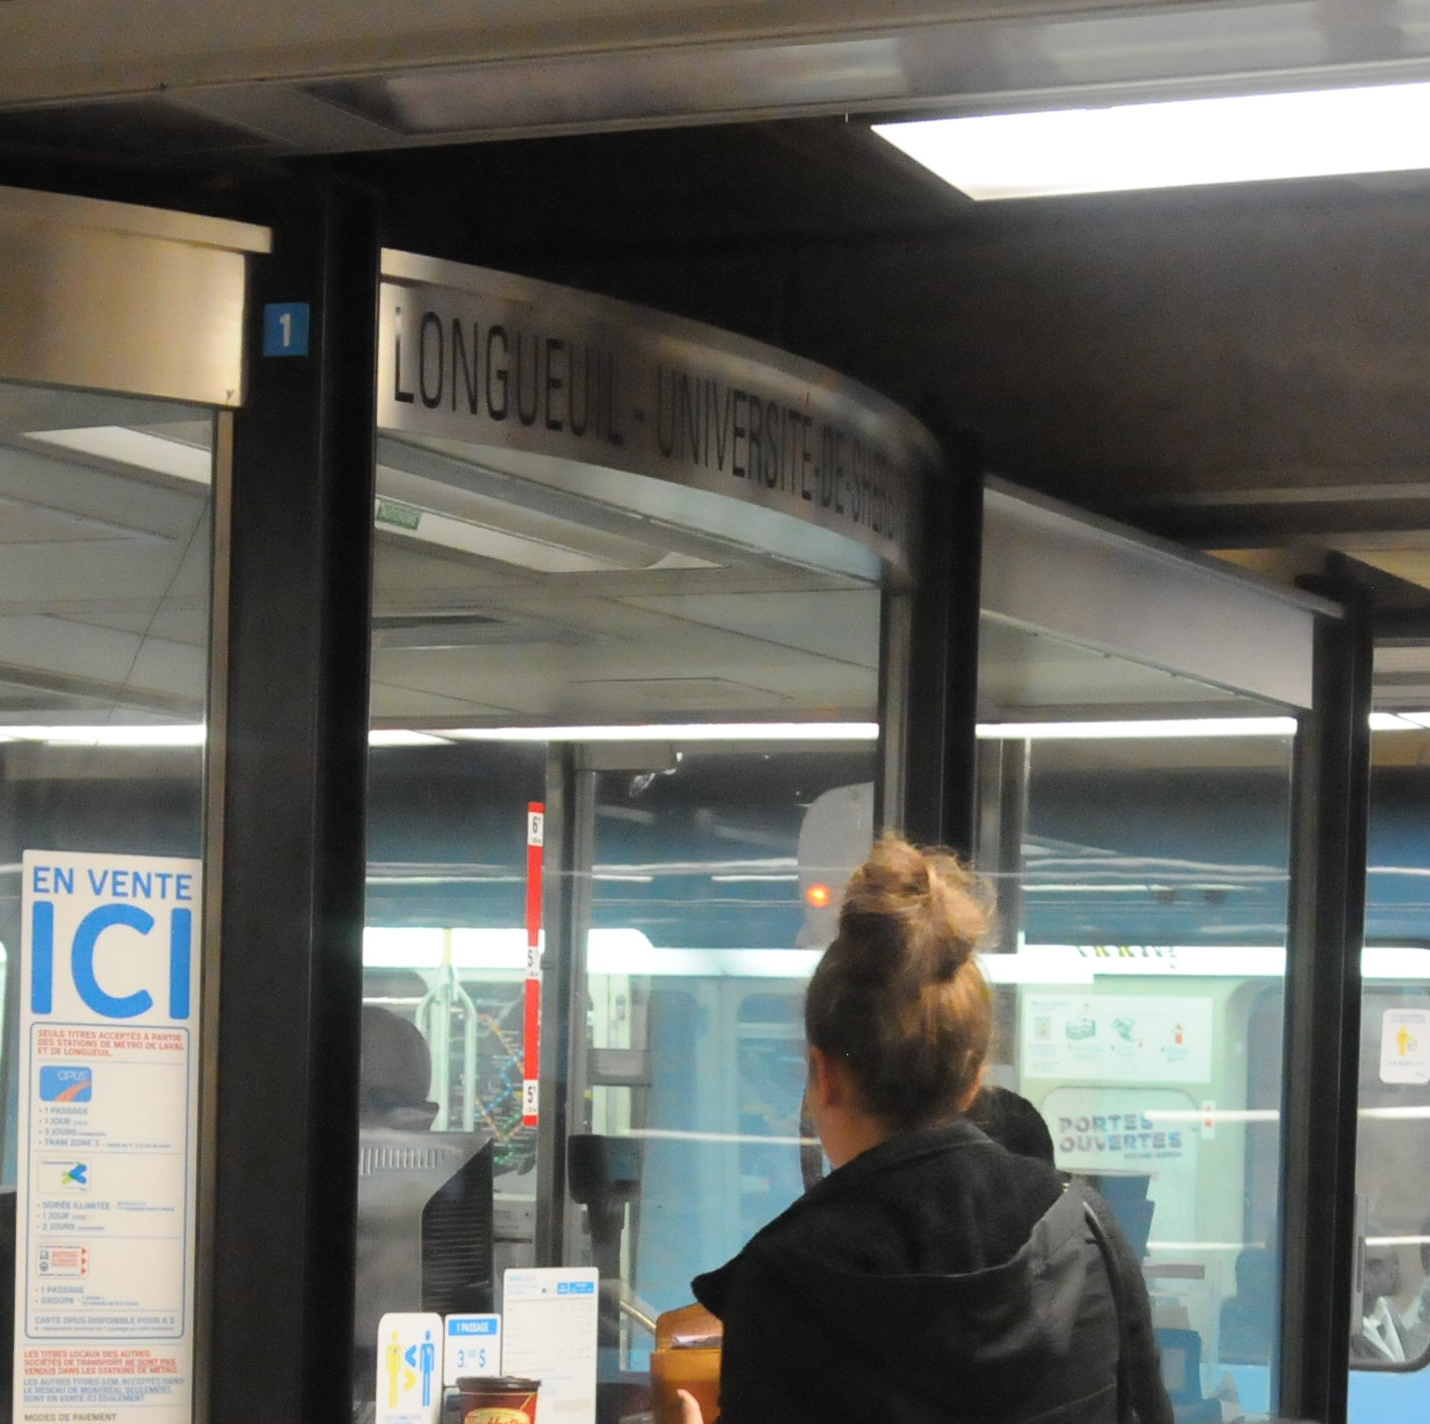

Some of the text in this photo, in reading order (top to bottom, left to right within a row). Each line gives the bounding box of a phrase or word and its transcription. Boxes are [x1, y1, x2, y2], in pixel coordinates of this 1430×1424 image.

[278, 312, 293, 348] 1
[393, 305, 624, 446] LONGUEUIL
[32, 866, 193, 901] EN VENTE
[31, 900, 192, 1020] ICI
[37, 1029, 65, 1038] SEULS
[68, 1030, 96, 1039] TITRES
[57, 1039, 98, 1047] STATIONS
[100, 1040, 111, 1048] DE
[57, 1071, 86, 1081] OPUS
[1059, 1114, 1153, 1134] PORTES
[1059, 1131, 1183, 1152] OUVERTES
[24, 1413, 117, 1421] MODES DE PAIEMENT
